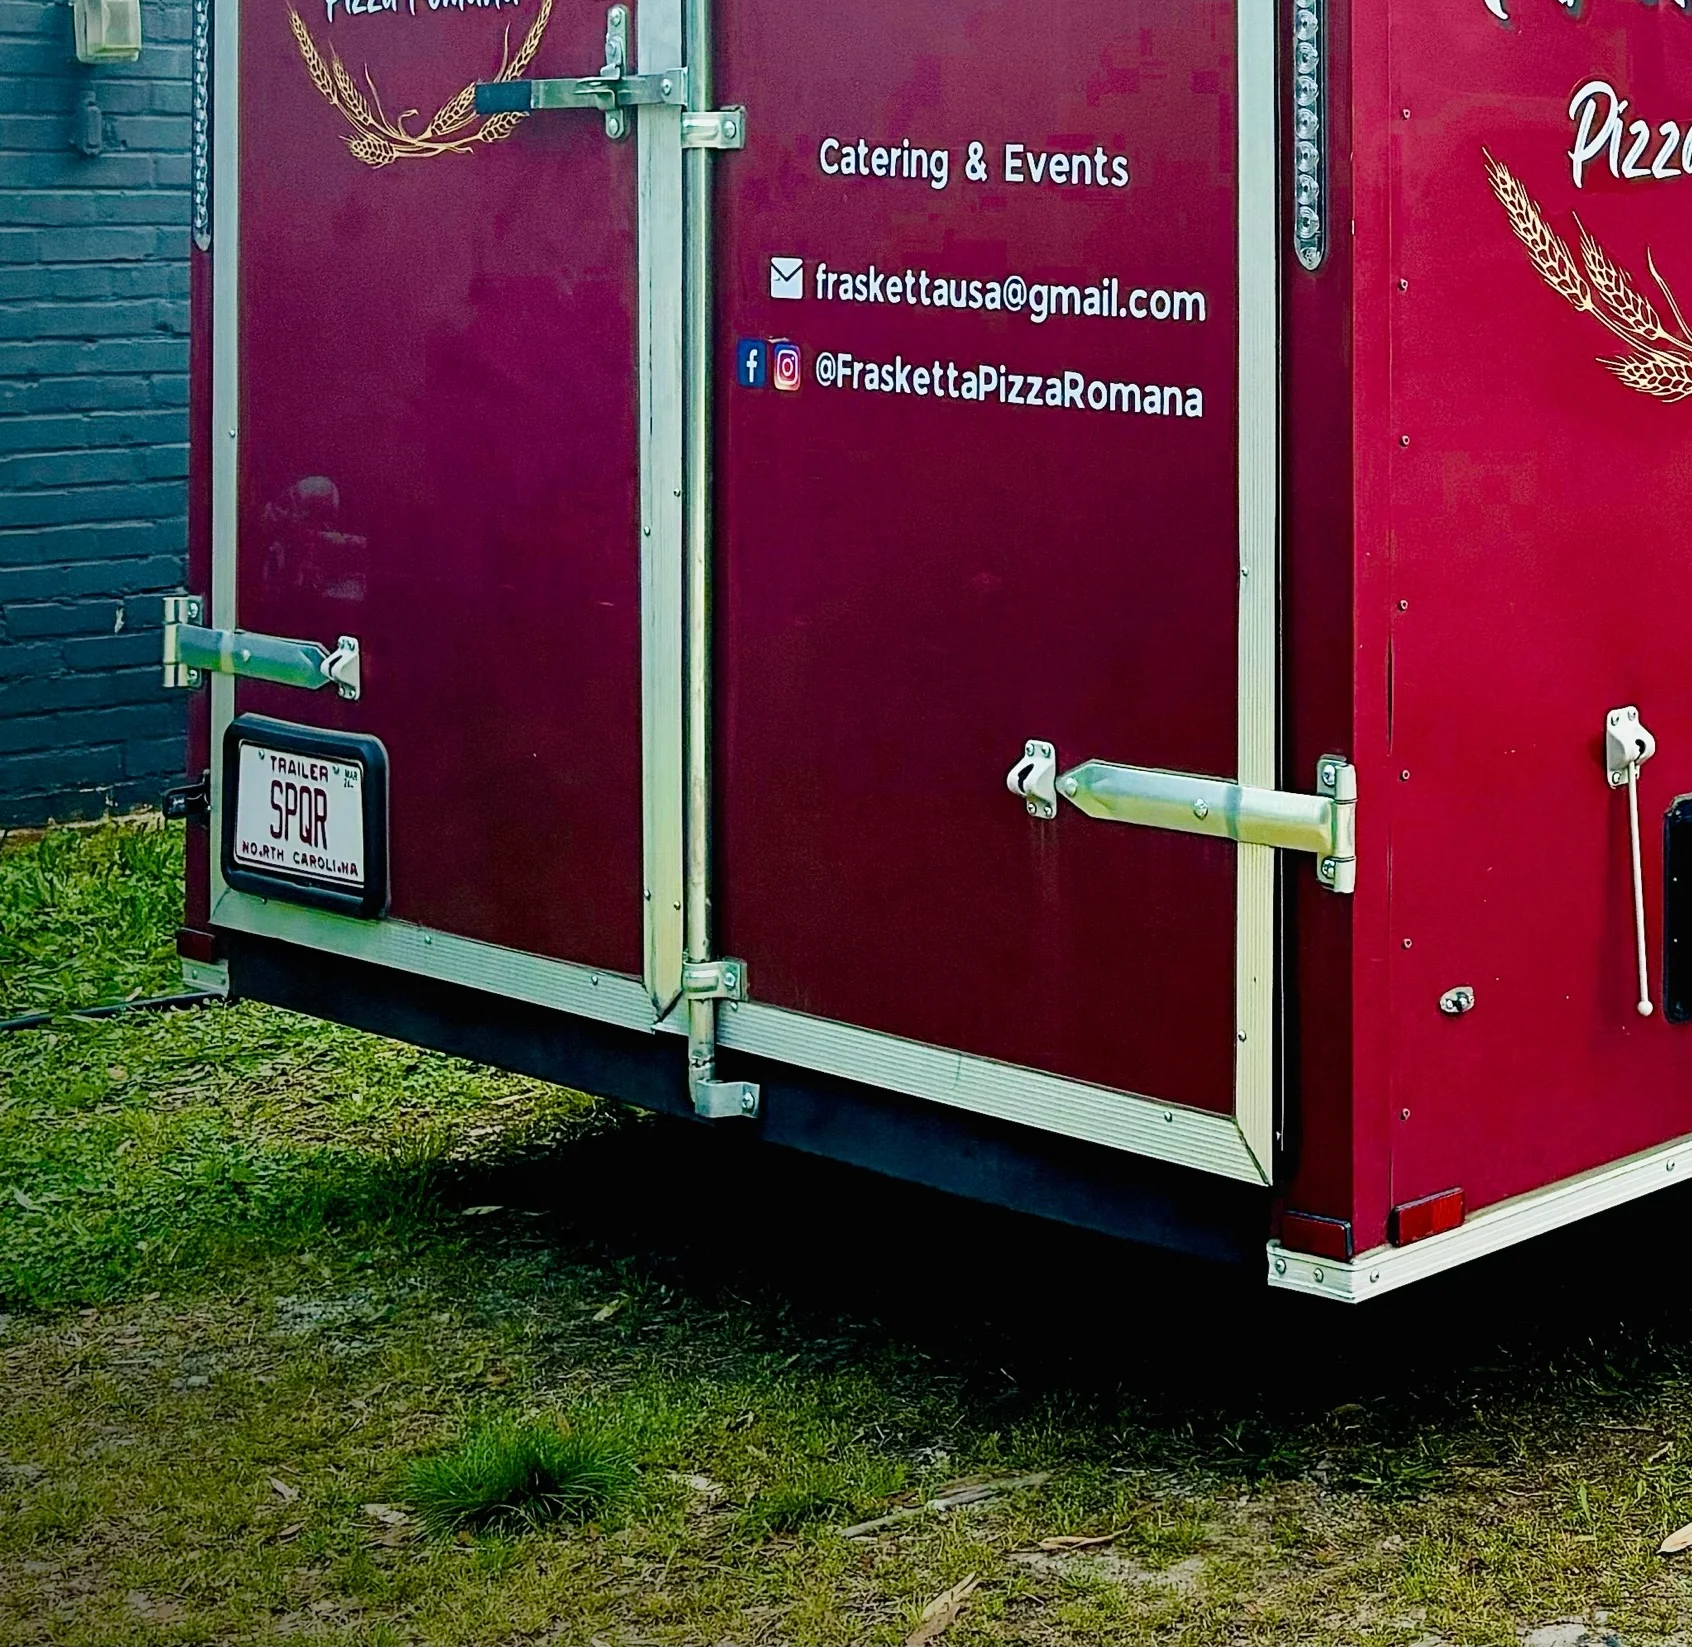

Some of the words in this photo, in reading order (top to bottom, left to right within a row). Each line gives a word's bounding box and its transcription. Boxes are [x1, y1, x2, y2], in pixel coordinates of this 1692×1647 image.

[819, 137, 949, 190] Catering
[965, 141, 988, 182] &
[1005, 143, 1129, 189] Events
[816, 263, 1207, 324] fraskettausa@gmail.com
[815, 351, 1204, 418] @FraskettaPizzaRomana
[270, 755, 329, 783] TRAILER
[270, 780, 328, 850] SPQR
[242, 840, 284, 861] NORTH
[293, 851, 358, 877] CAROLINA
